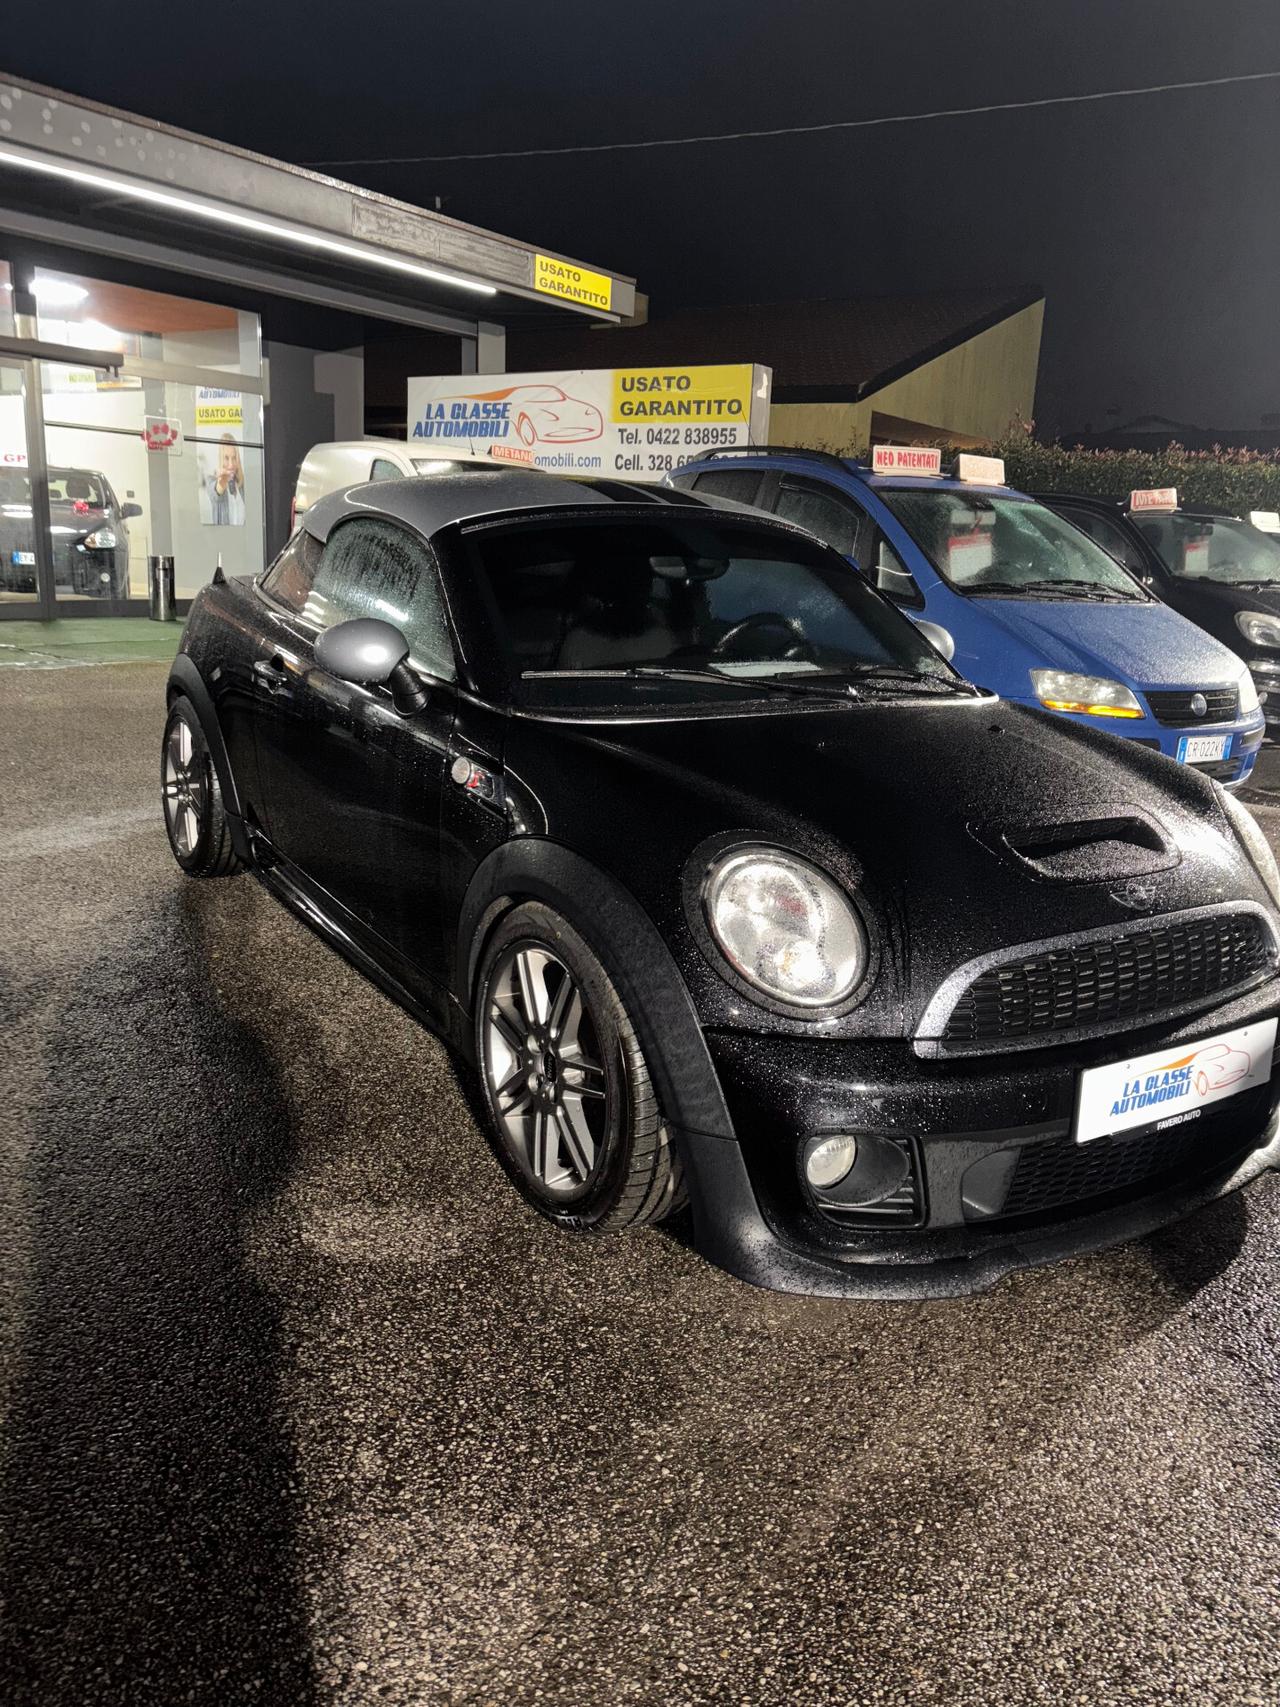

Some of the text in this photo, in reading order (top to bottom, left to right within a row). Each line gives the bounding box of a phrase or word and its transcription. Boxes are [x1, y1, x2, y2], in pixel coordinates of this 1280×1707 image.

[540, 261, 581, 282] USATO
[539, 277, 608, 305] GARANTITO
[621, 376, 691, 392] USATO
[199, 408, 226, 418] USATO
[426, 402, 512, 420] LA CLASSE
[620, 399, 742, 416] GARANTITO
[413, 420, 510, 438] AUTOMOBILI
[618, 427, 737, 445] Tel. 0422 838955
[535, 453, 601, 468] omobili.com
[615, 454, 643, 471] Cell.
[648, 454, 672, 471] 328
[876, 450, 938, 469] NEO PATENTATI
[1122, 1065, 1194, 1097] LA CLASSE
[1110, 1080, 1192, 1117] AUTOMOBILI
[1157, 1109, 1201, 1131] FAVERO AUTO
